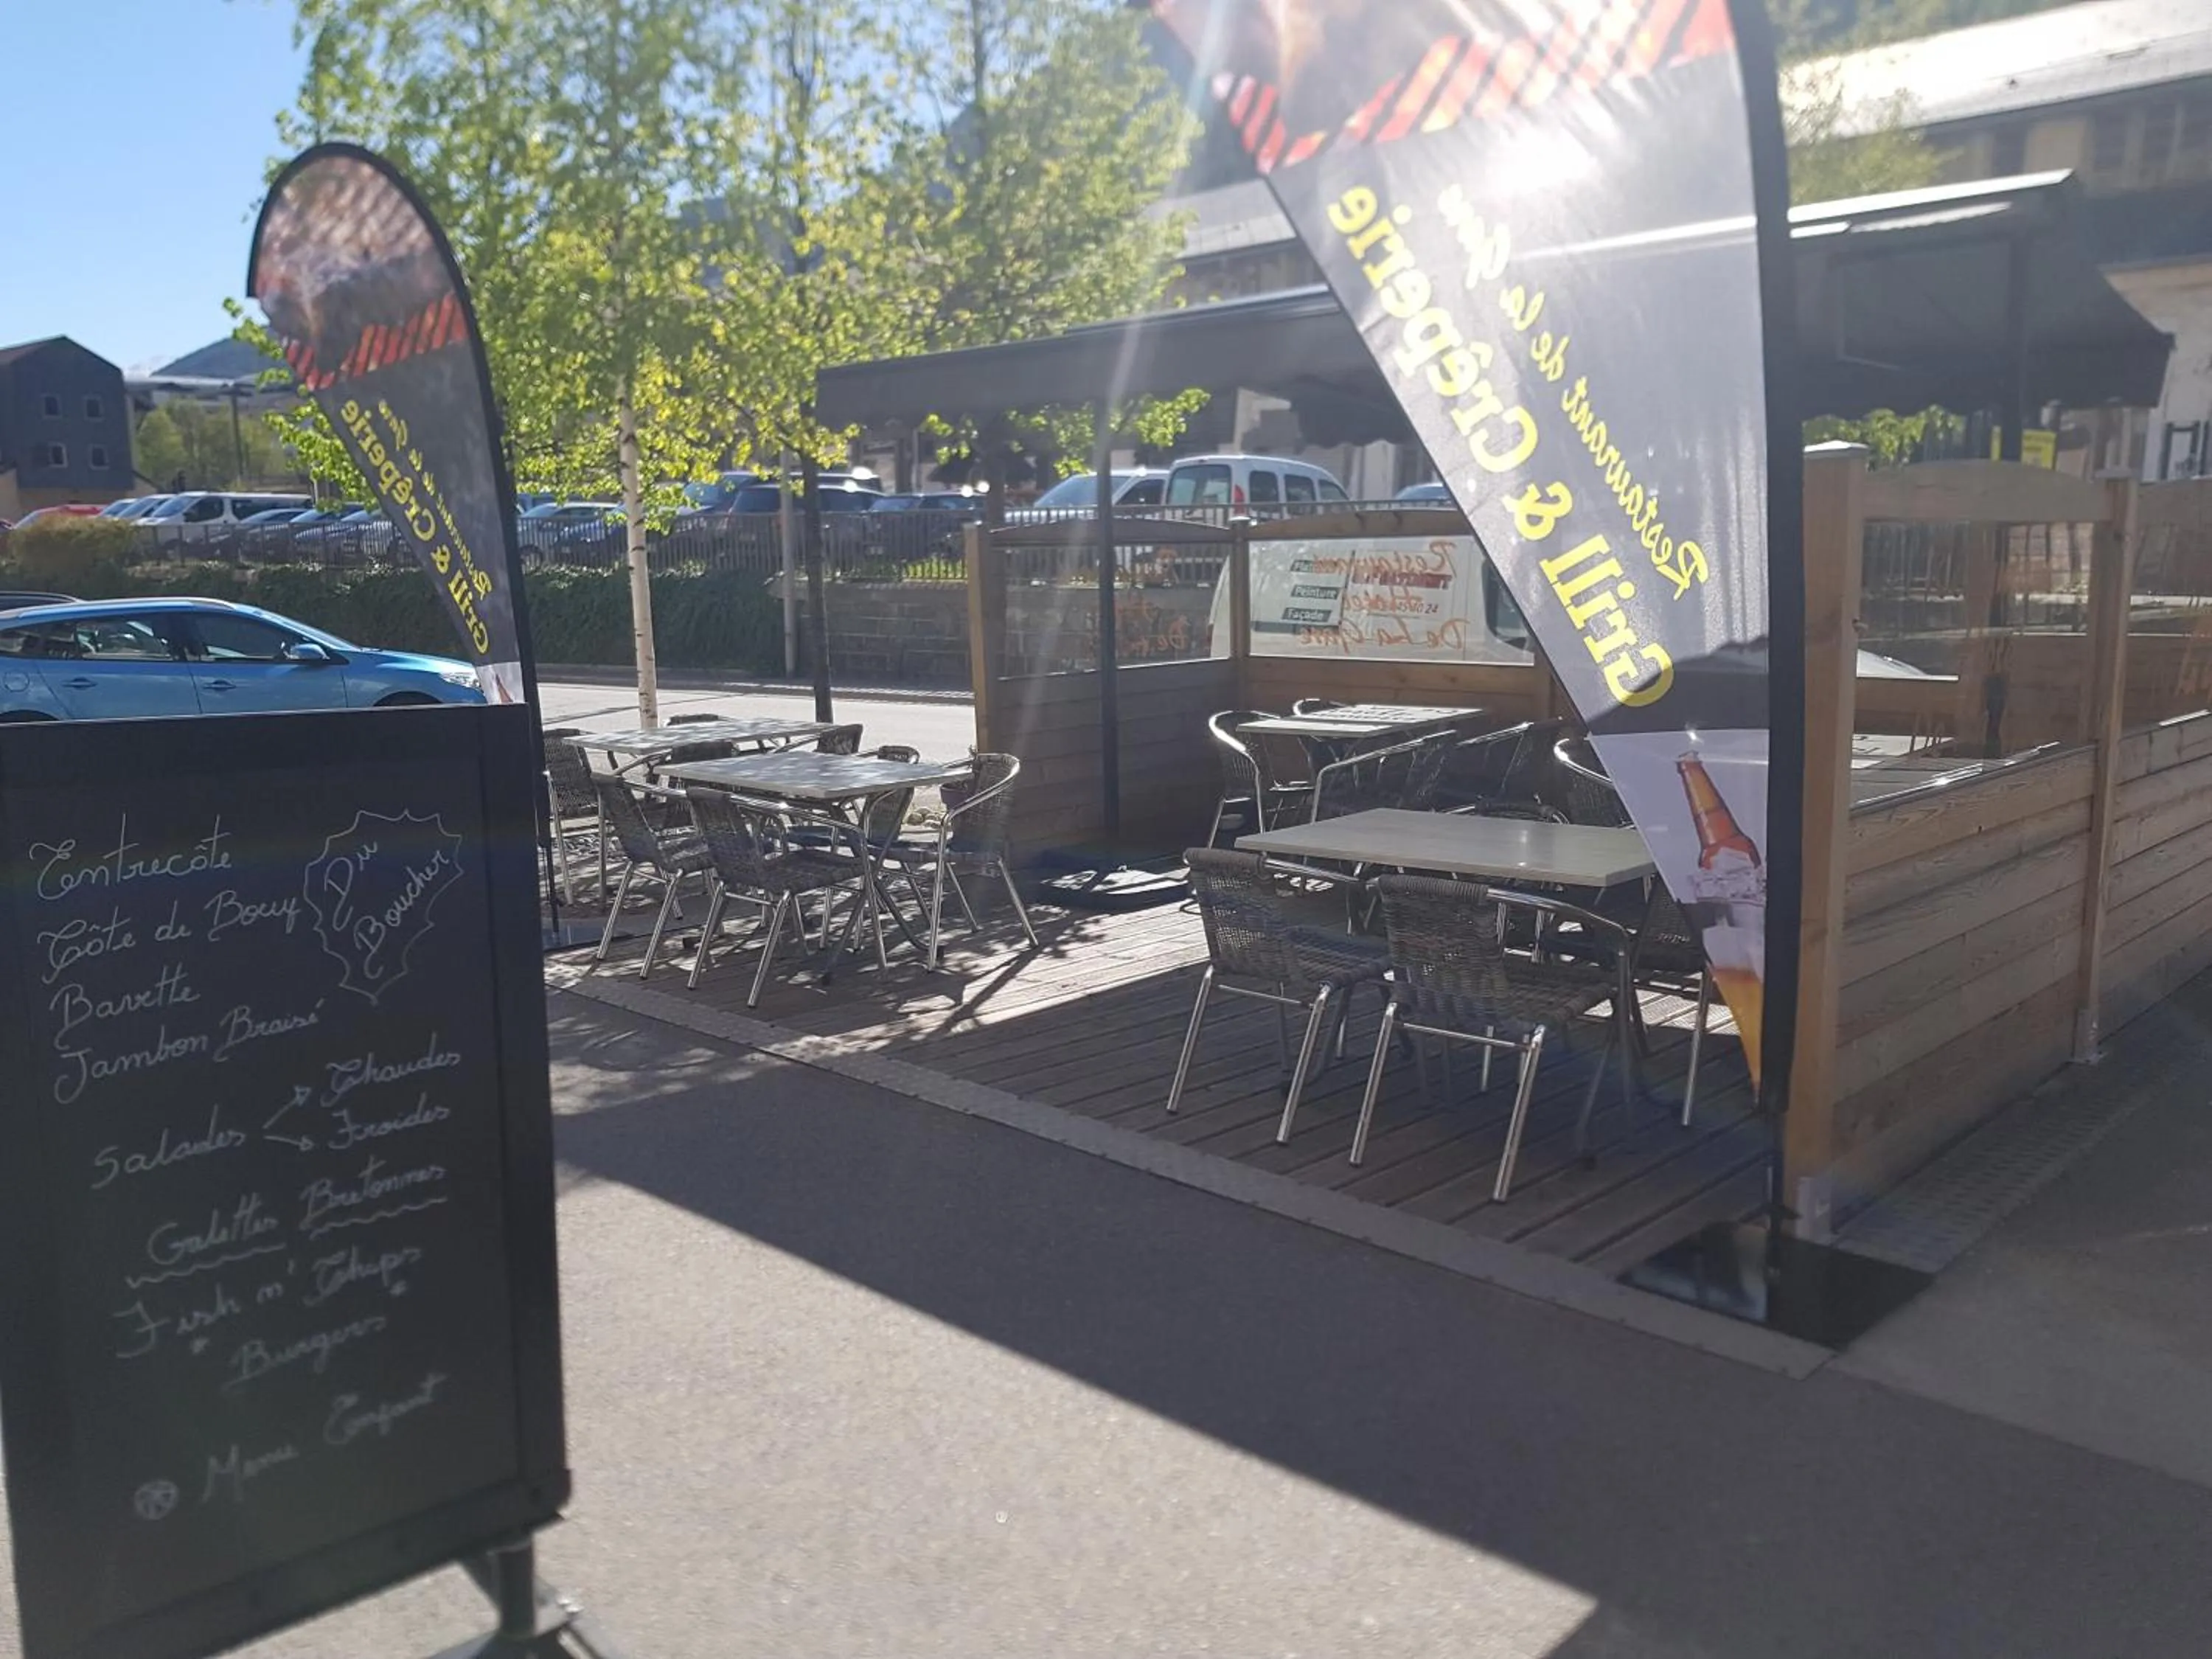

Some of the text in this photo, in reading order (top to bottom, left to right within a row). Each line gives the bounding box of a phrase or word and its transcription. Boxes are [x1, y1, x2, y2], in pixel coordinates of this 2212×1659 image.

[29, 813, 233, 900] Entrecôte
[154, 900, 192, 942] de
[353, 849, 450, 978] Boucher
[49, 961, 201, 1050] Bavette
[54, 998, 326, 1104] Jambon Braisé
[320, 1032, 461, 1107] Chaudes
[91, 1104, 246, 1189] Salades
[328, 1092, 450, 1149] Froides
[147, 1192, 279, 1265] Galettes
[112, 1282, 242, 1359] Fish
[223, 1315, 387, 1389] Burgers
